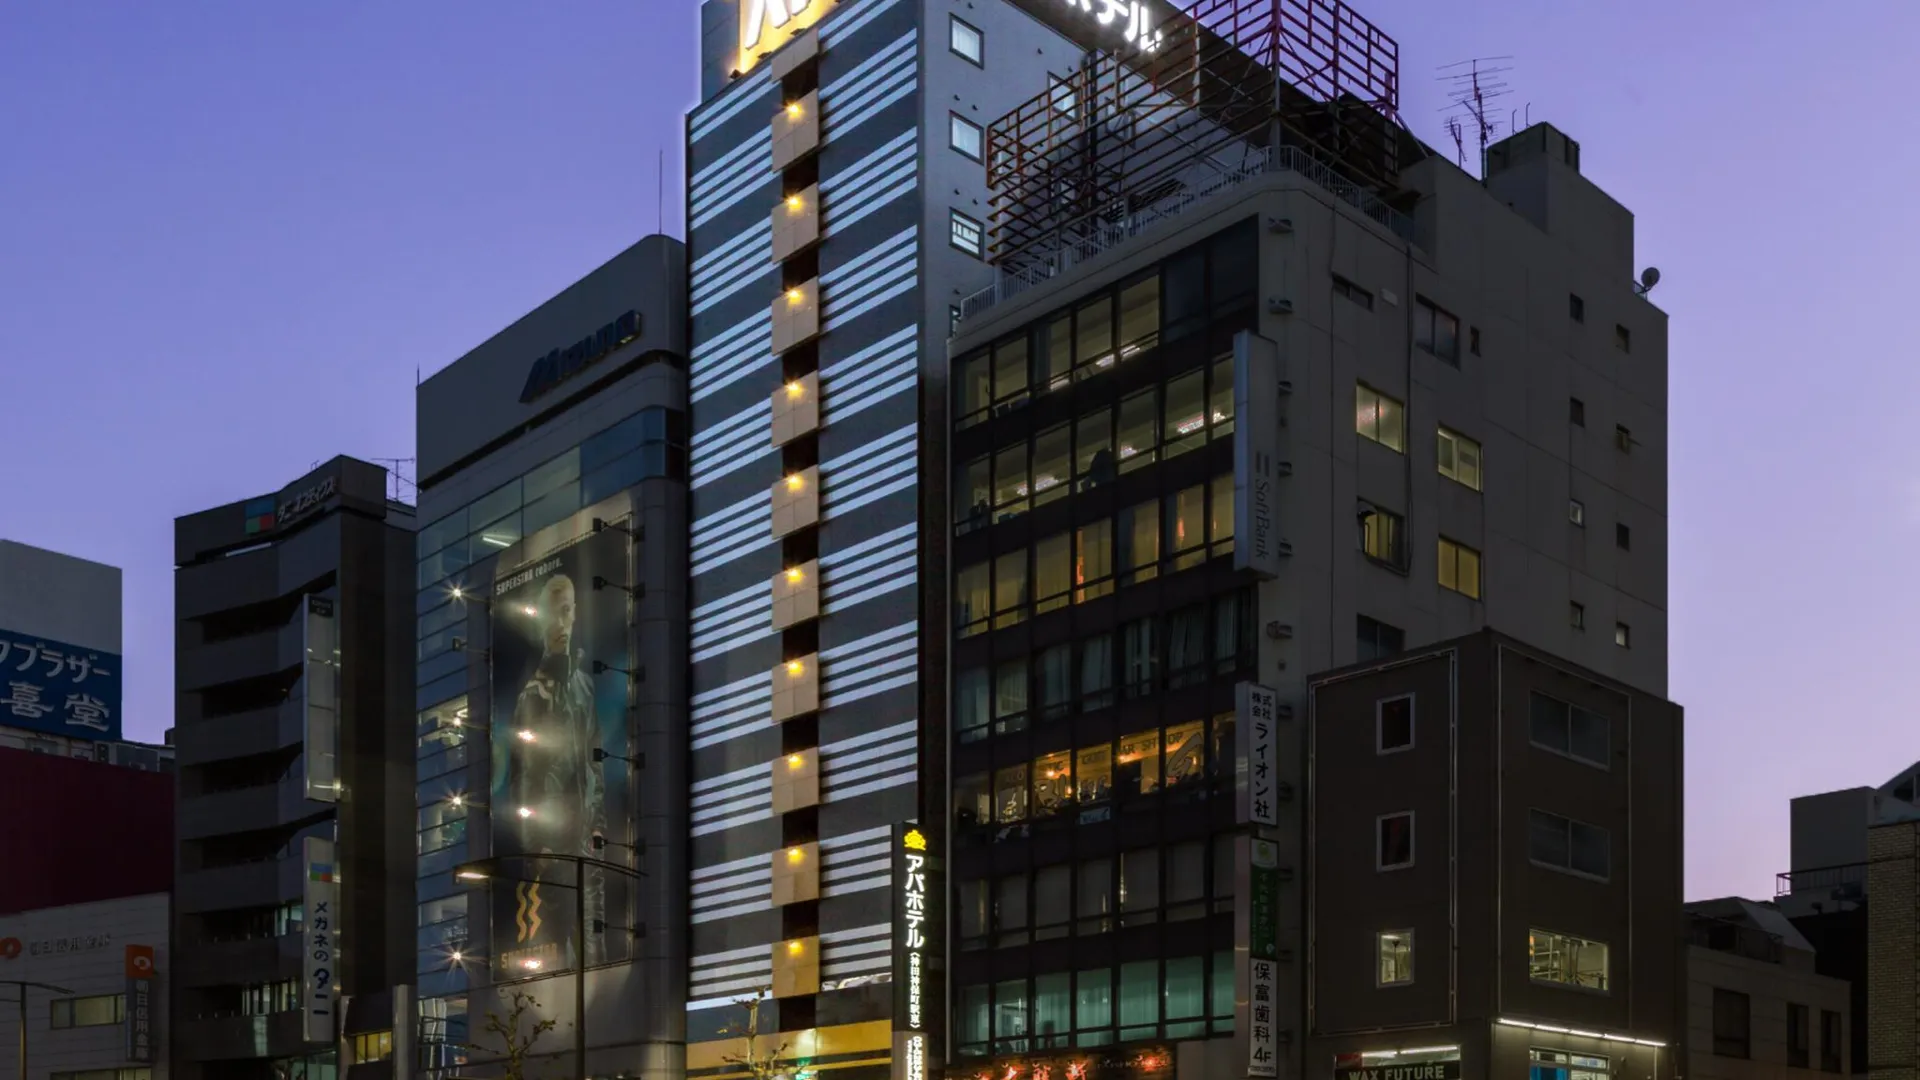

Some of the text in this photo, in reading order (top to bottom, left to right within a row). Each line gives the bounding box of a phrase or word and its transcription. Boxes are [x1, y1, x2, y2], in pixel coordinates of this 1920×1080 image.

[1255, 722, 1270, 818] ライオン社
[905, 854, 925, 948] アパホテル
[1254, 962, 1271, 1043] 保富歯科
[1253, 1047, 1272, 1063] 4F
[1384, 1065, 1445, 1080] FUTURE
